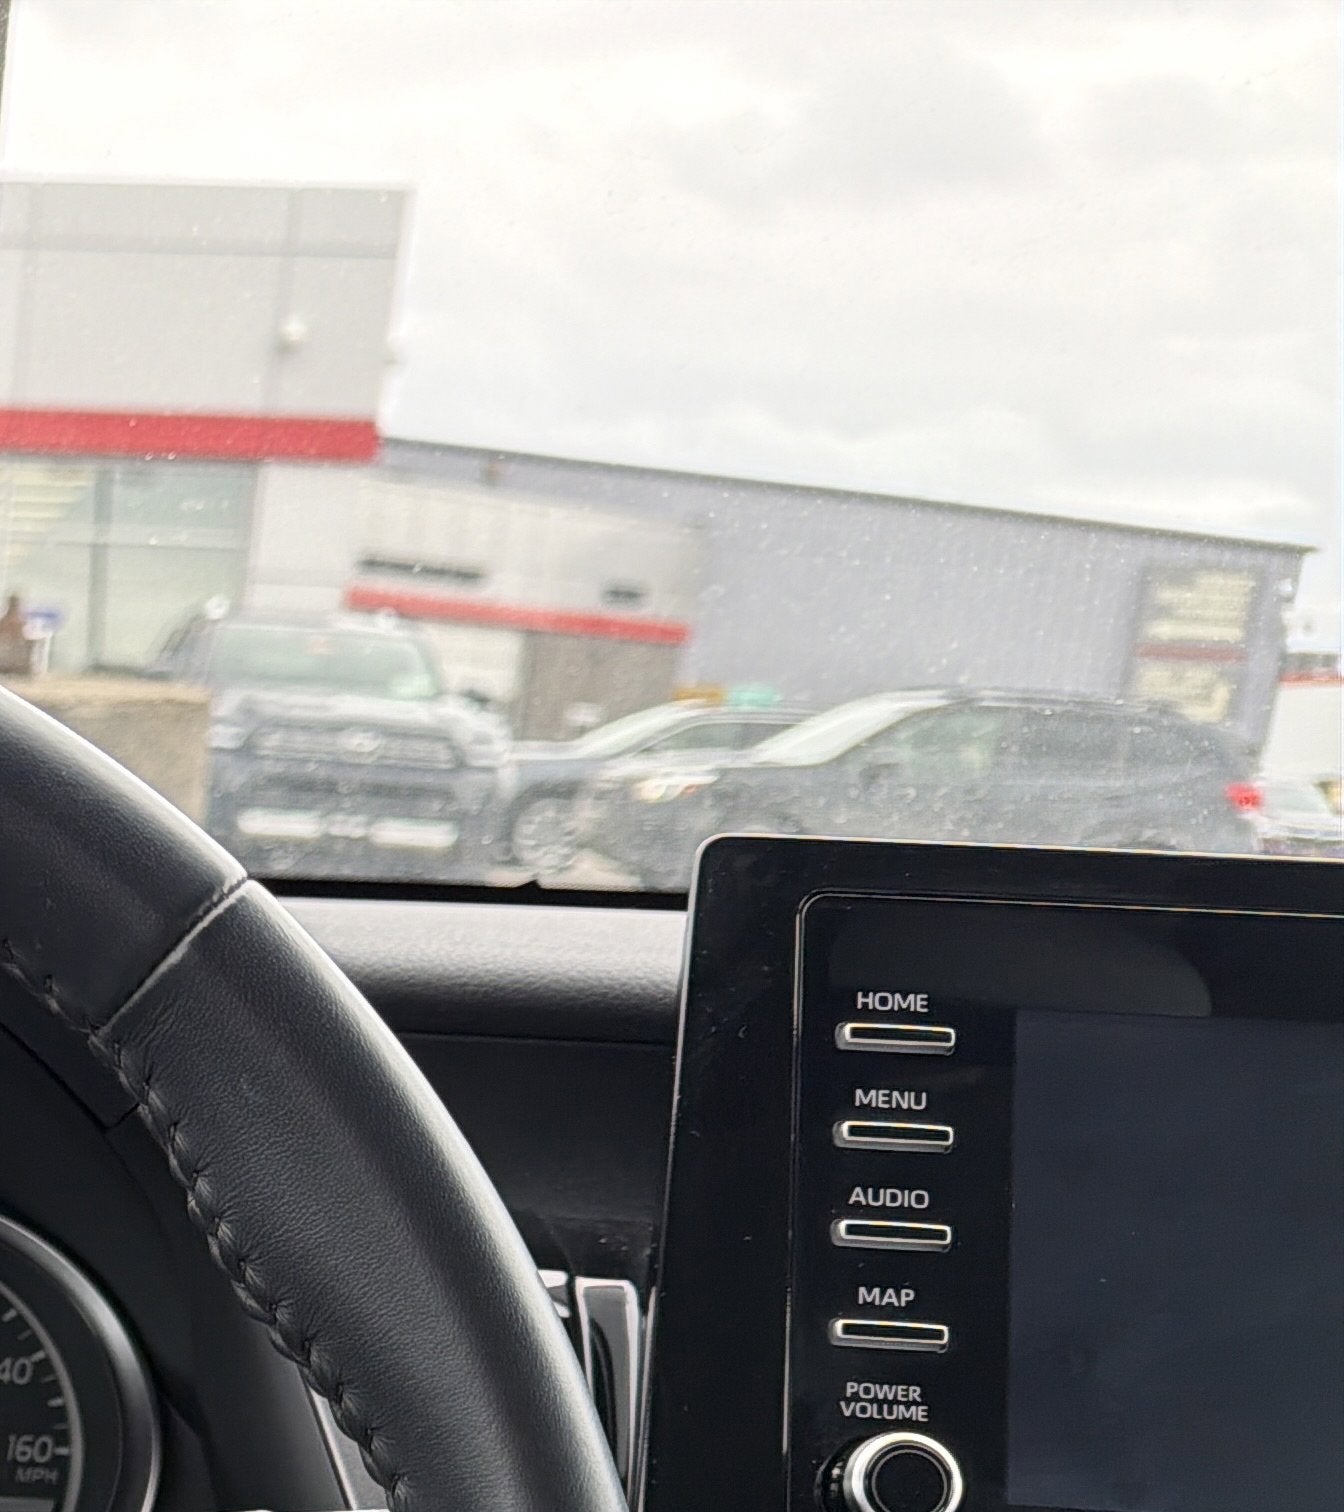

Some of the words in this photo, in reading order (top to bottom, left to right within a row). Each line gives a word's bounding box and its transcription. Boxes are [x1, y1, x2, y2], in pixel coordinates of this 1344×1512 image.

[856, 991, 930, 1013] HOME
[854, 1088, 928, 1111] MENU
[848, 1186, 930, 1210] AUDIO
[857, 1286, 916, 1308] MAP
[845, 1381, 922, 1403] POWER
[838, 1401, 929, 1423] VOLUME
[7, 1434, 54, 1463] 160
[14, 1465, 60, 1486] MPH
